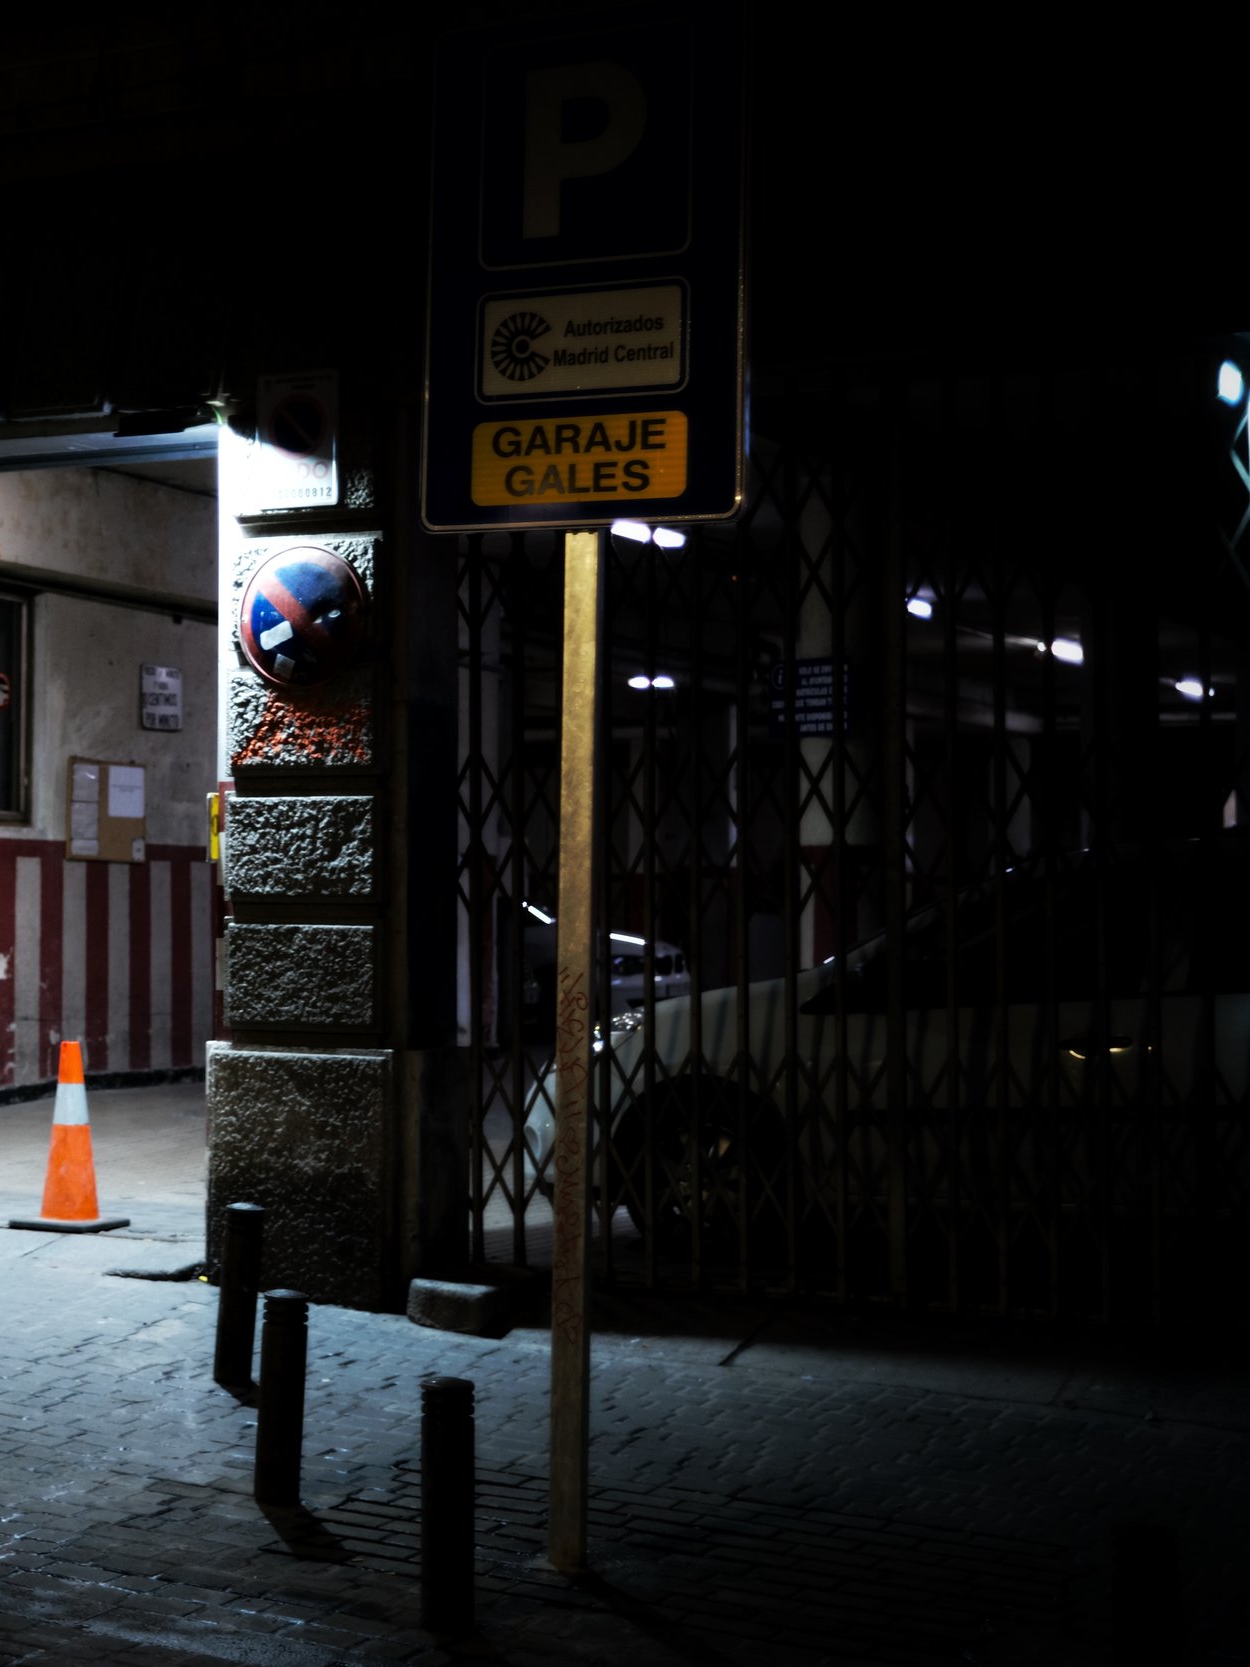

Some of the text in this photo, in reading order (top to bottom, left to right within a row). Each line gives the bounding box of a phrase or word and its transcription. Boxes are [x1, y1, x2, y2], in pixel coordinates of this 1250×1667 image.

[523, 61, 648, 240] P
[563, 314, 665, 338] Autorizados
[553, 341, 675, 367] Madrid Central
[491, 418, 667, 458] GARAJE
[504, 460, 651, 497] GALES
